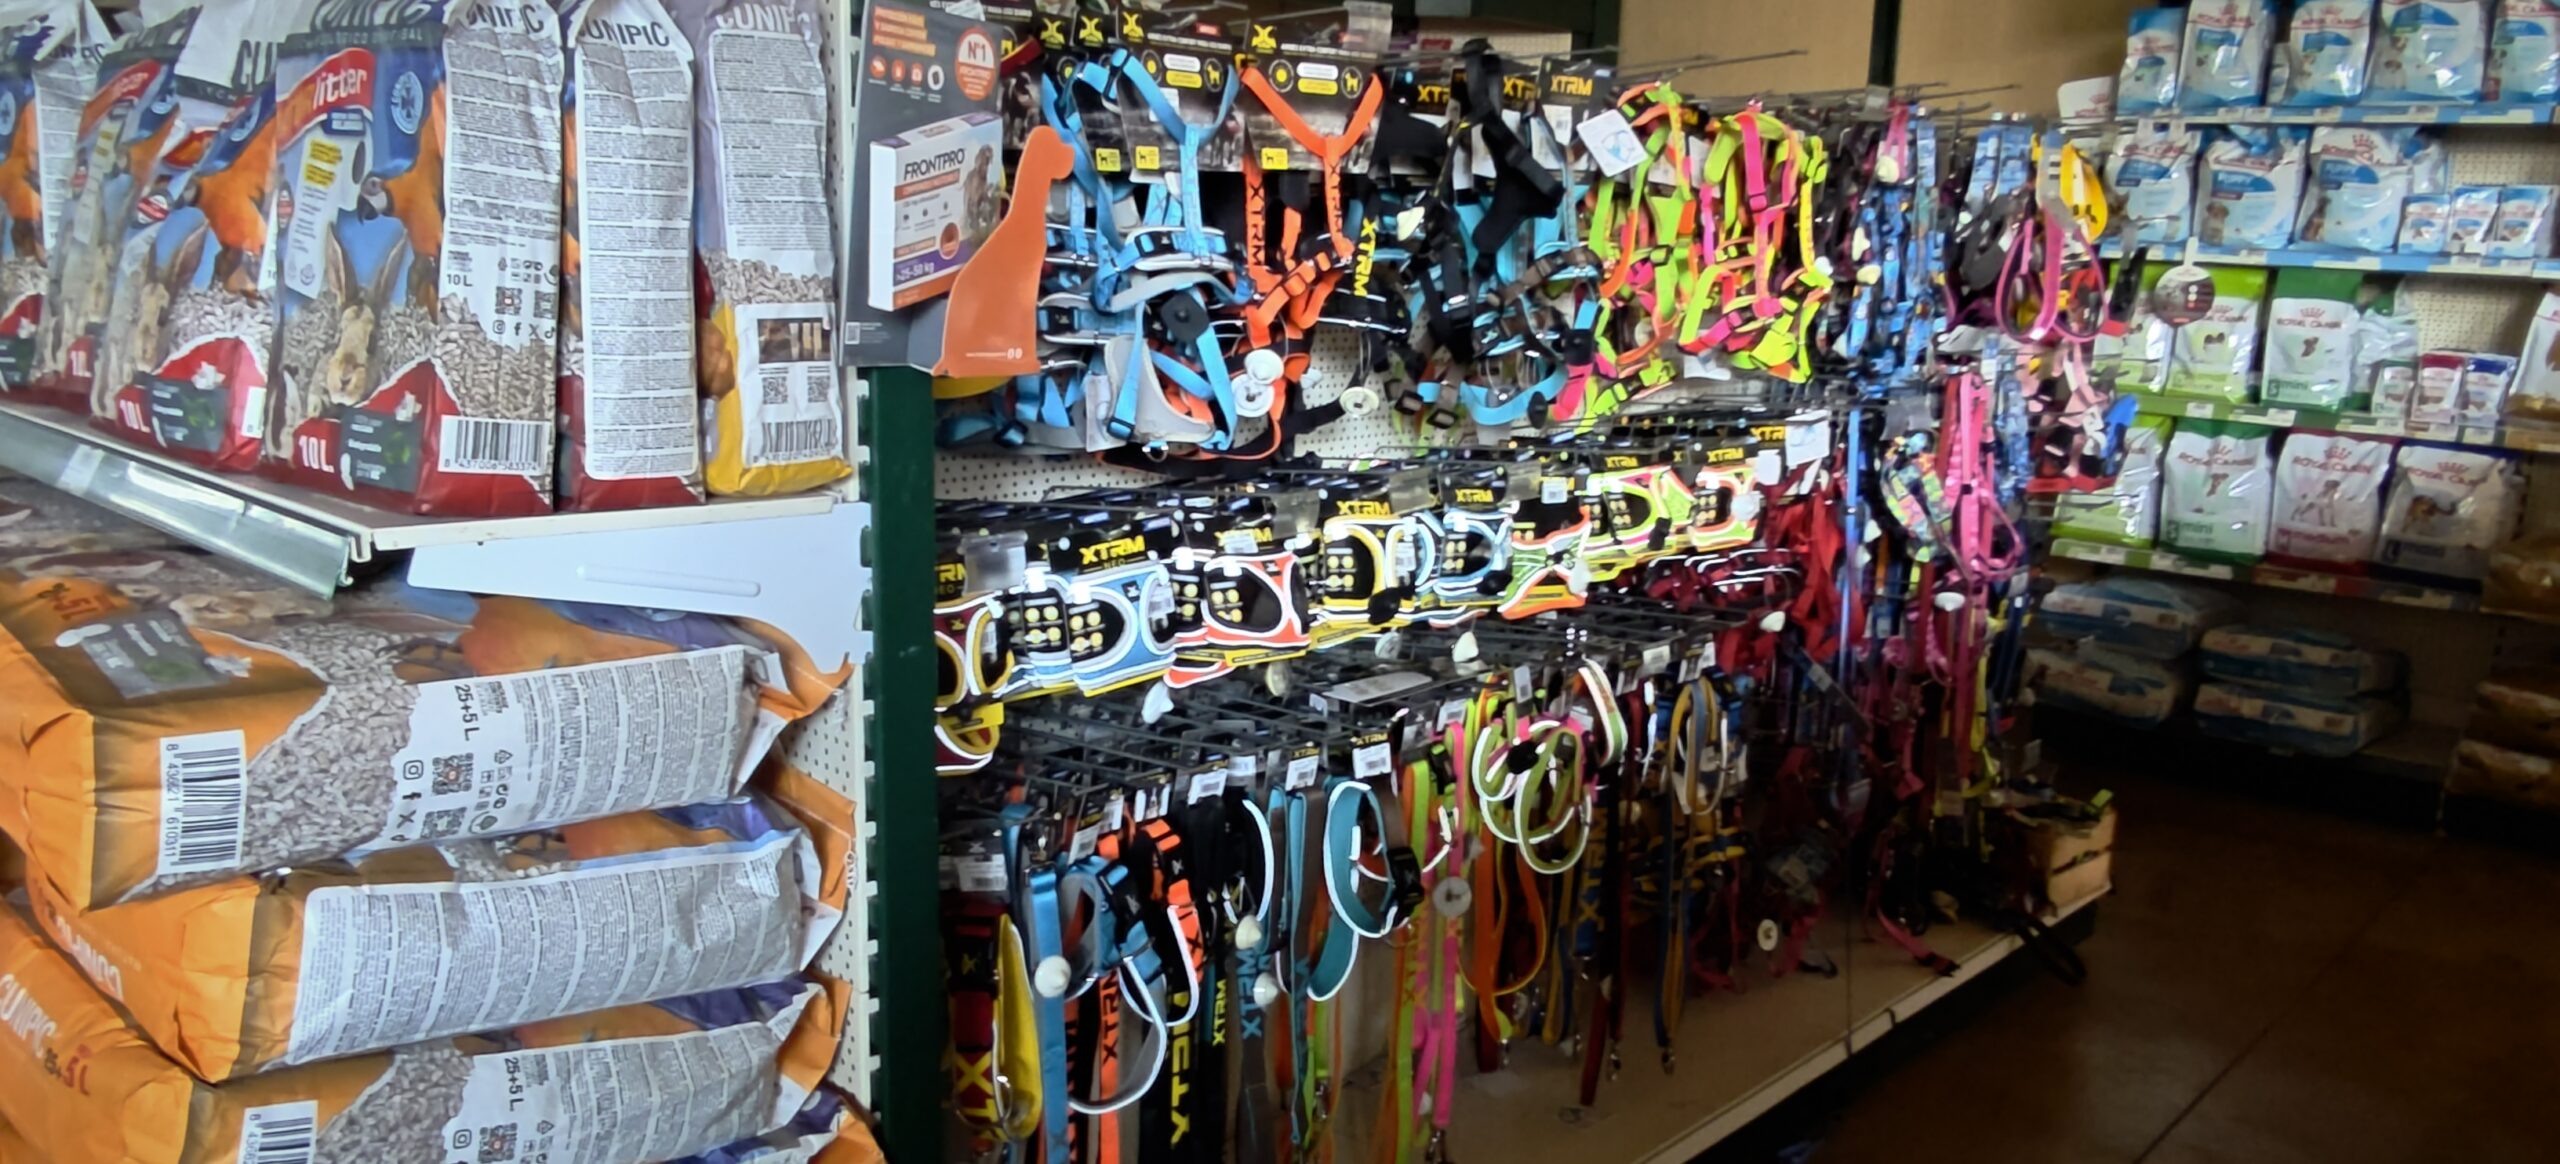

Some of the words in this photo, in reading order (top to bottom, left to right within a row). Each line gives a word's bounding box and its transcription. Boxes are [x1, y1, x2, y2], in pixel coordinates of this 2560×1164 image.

[313, 69, 367, 109] litter
[1551, 75, 1592, 95] XTRM
[904, 148, 966, 181] FRONTPRO
[1251, 183, 1265, 266] XTRM
[1354, 216, 1379, 297] XTRM
[447, 274, 461, 286] 10
[463, 275, 473, 287] L
[2276, 317, 2305, 327] ROYAL
[2310, 318, 2342, 328] CANIN
[298, 435, 335, 473] 10L
[1606, 456, 1639, 468] XTRM
[1707, 448, 1745, 464] XTRM
[1336, 500, 1391, 515] XTRM
[1456, 489, 1494, 502] XTRM
[1079, 534, 1145, 565] XTRM
[454, 684, 478, 723] 25+5
[464, 726, 480, 741] L
[166, 743, 179, 752] 8
[1237, 950, 1264, 1041] XTRM
[1212, 978, 1227, 1047] XTRM
[504, 1056, 523, 1095] 25+5
[509, 1097, 525, 1112] L
